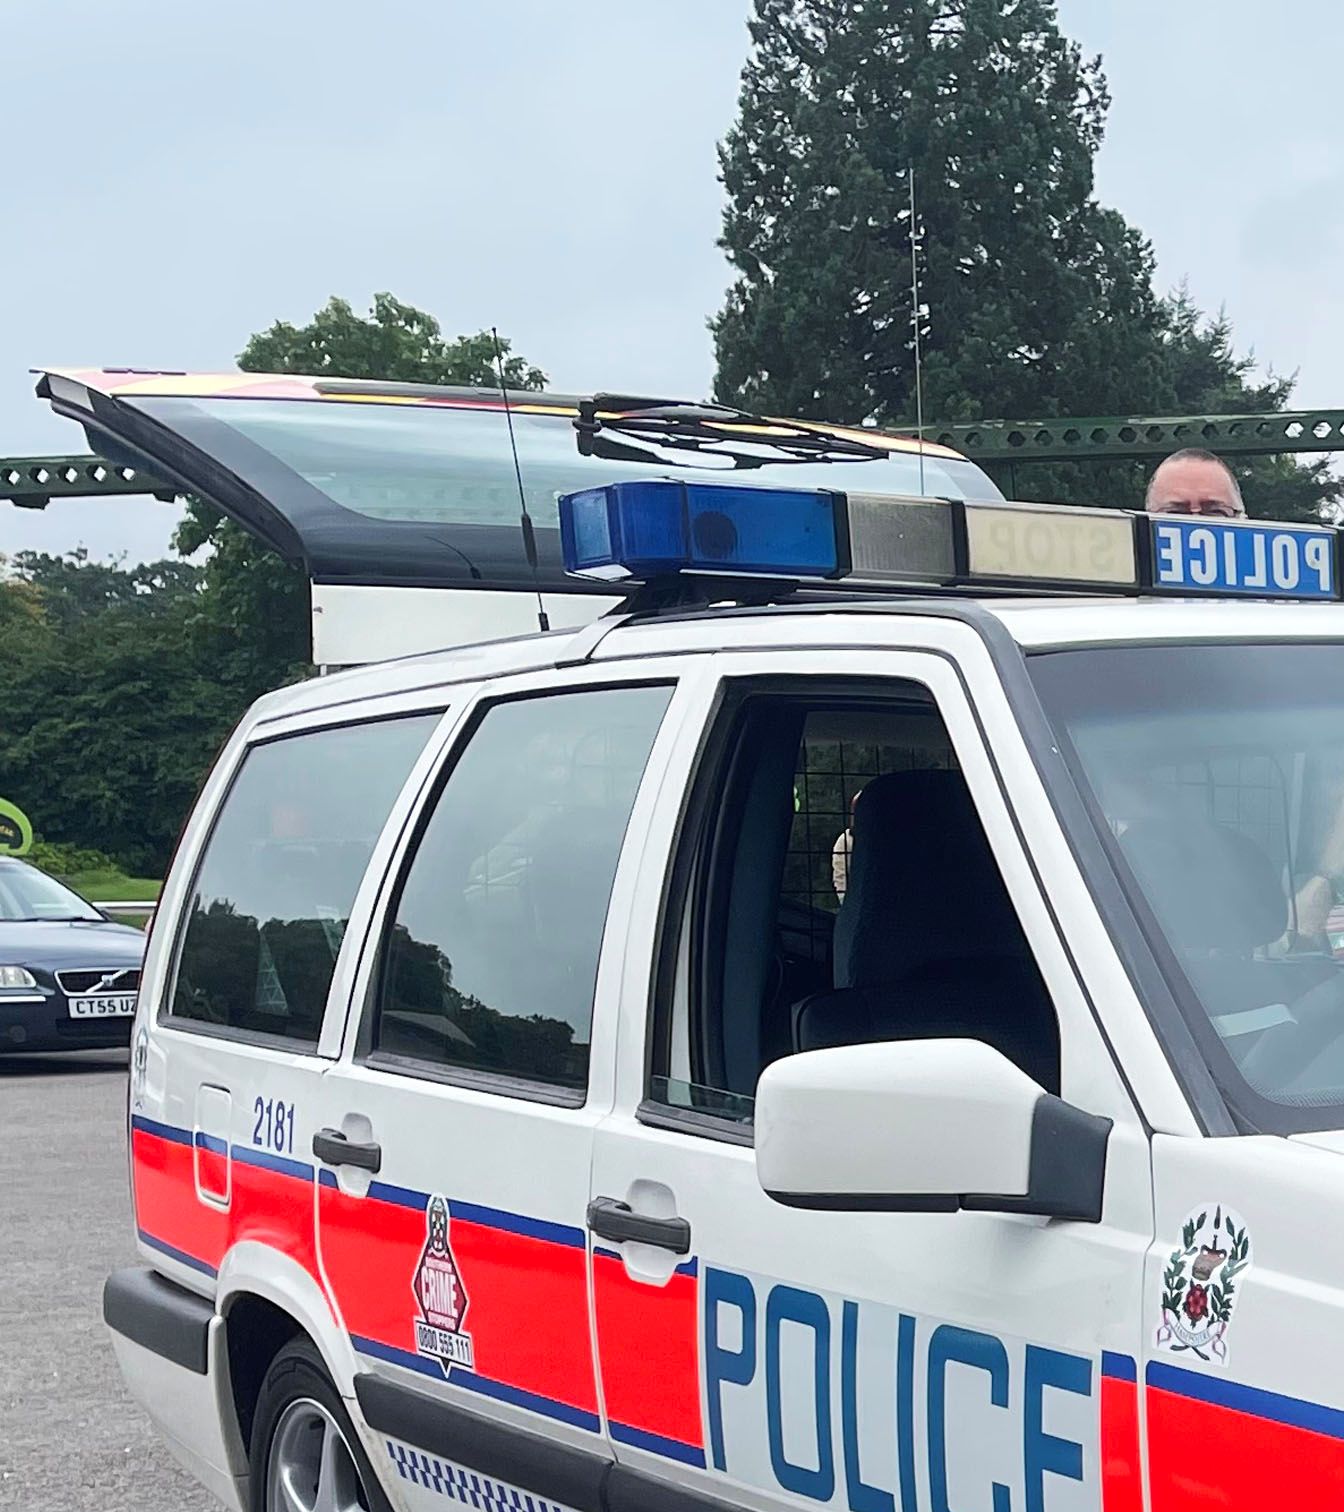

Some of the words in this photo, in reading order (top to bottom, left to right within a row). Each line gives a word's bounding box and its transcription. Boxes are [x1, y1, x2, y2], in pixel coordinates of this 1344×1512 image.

[76, 1000, 116, 1015] CT55
[253, 1096, 295, 1154] 2181
[421, 1266, 458, 1319] CRIME
[418, 1325, 438, 1351] 0800
[456, 1337, 472, 1364] 111
